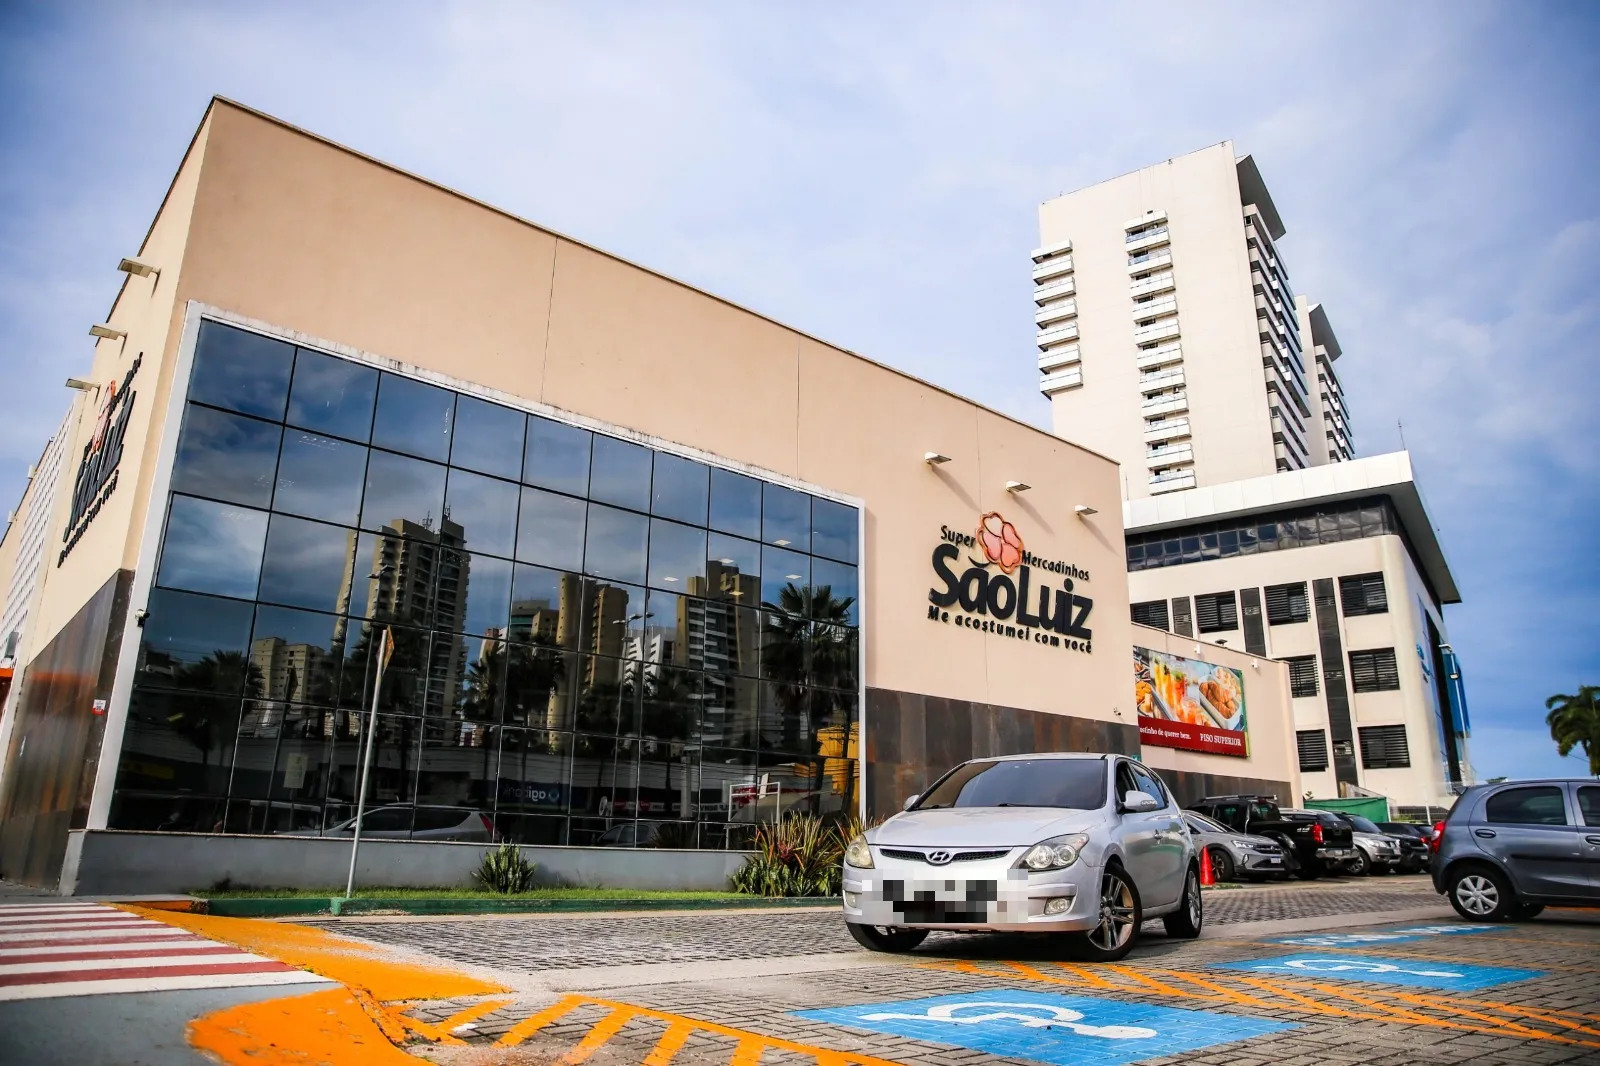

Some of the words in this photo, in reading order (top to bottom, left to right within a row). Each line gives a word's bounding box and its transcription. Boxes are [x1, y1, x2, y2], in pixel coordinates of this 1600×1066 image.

[940, 524, 976, 547] Super
[1021, 550, 1090, 581] Mercadinhos
[927, 605, 949, 623] Me
[954, 613, 1030, 641] acostumei
[1034, 632, 1060, 647] com
[1064, 640, 1092, 654] você
[1199, 733, 1213, 743] PISO
[1213, 735, 1242, 747] SUPERIOR
